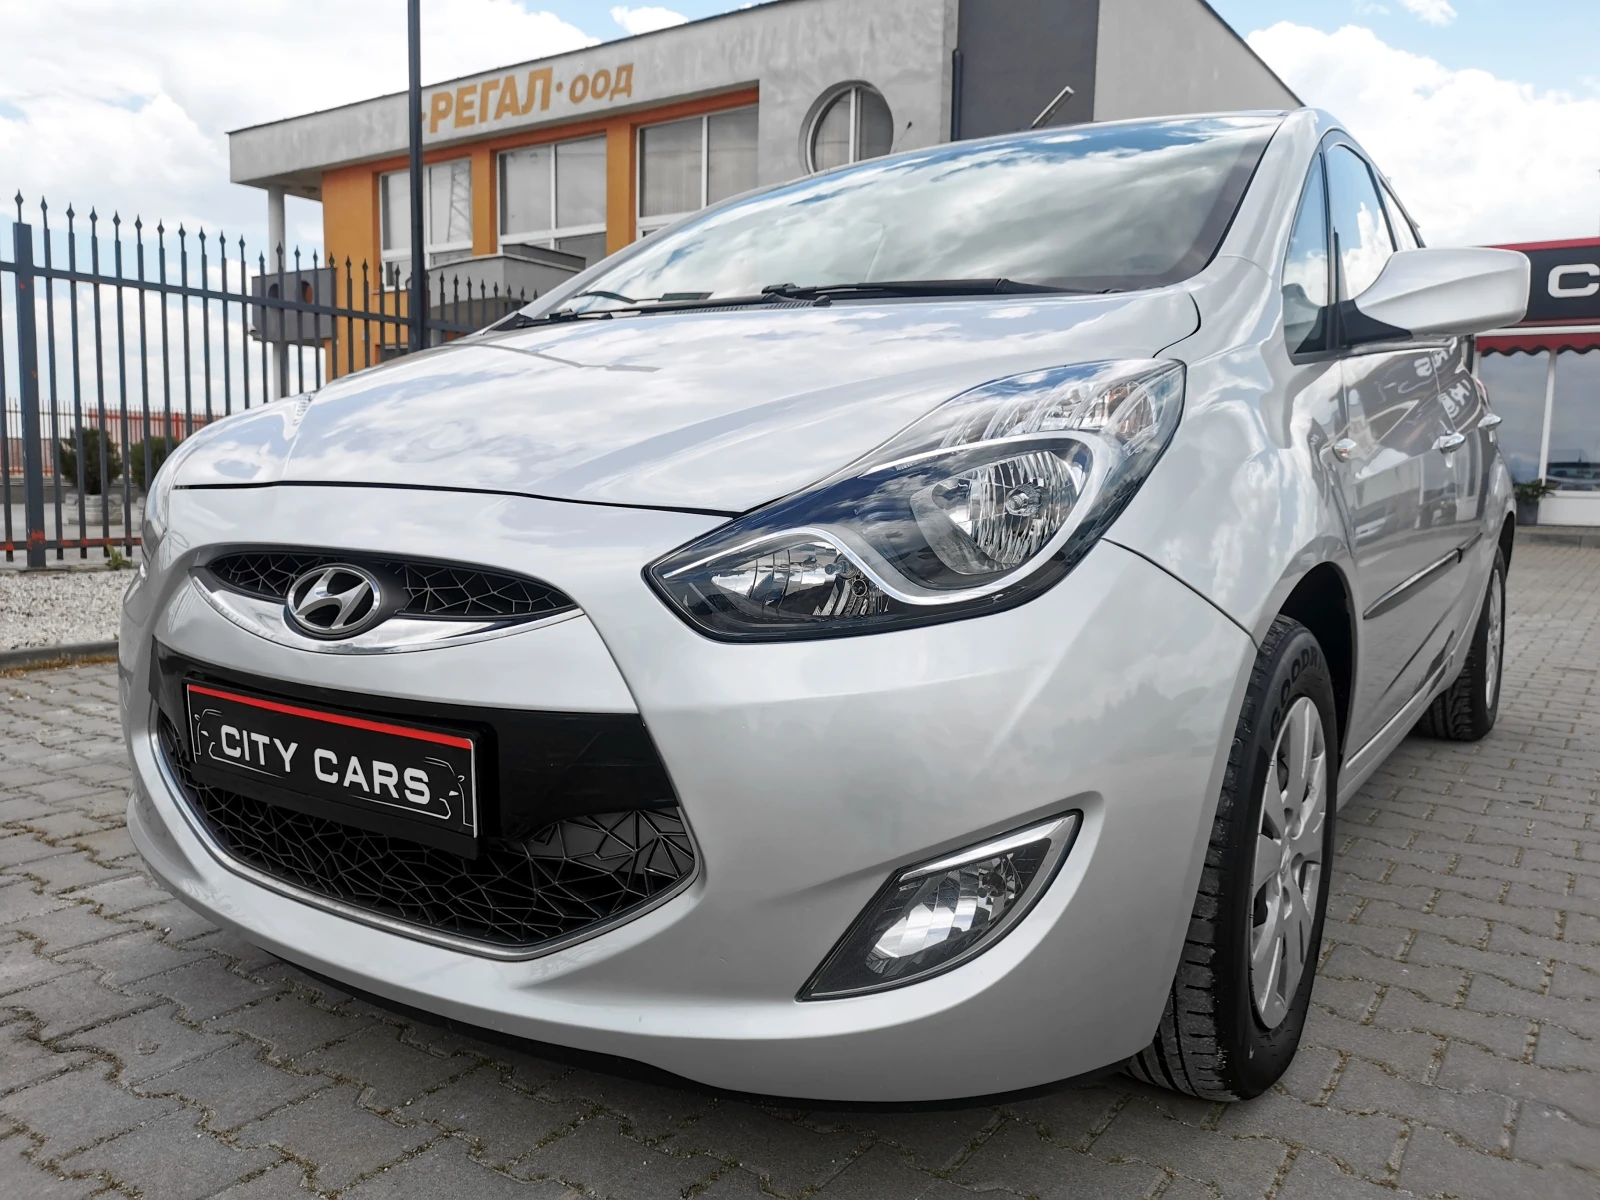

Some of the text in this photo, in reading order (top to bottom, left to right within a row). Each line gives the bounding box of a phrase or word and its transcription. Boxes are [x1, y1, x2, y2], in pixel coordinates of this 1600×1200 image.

[429, 67, 553, 134] РЕГАЛ
[220, 724, 431, 805] CITY CARS
